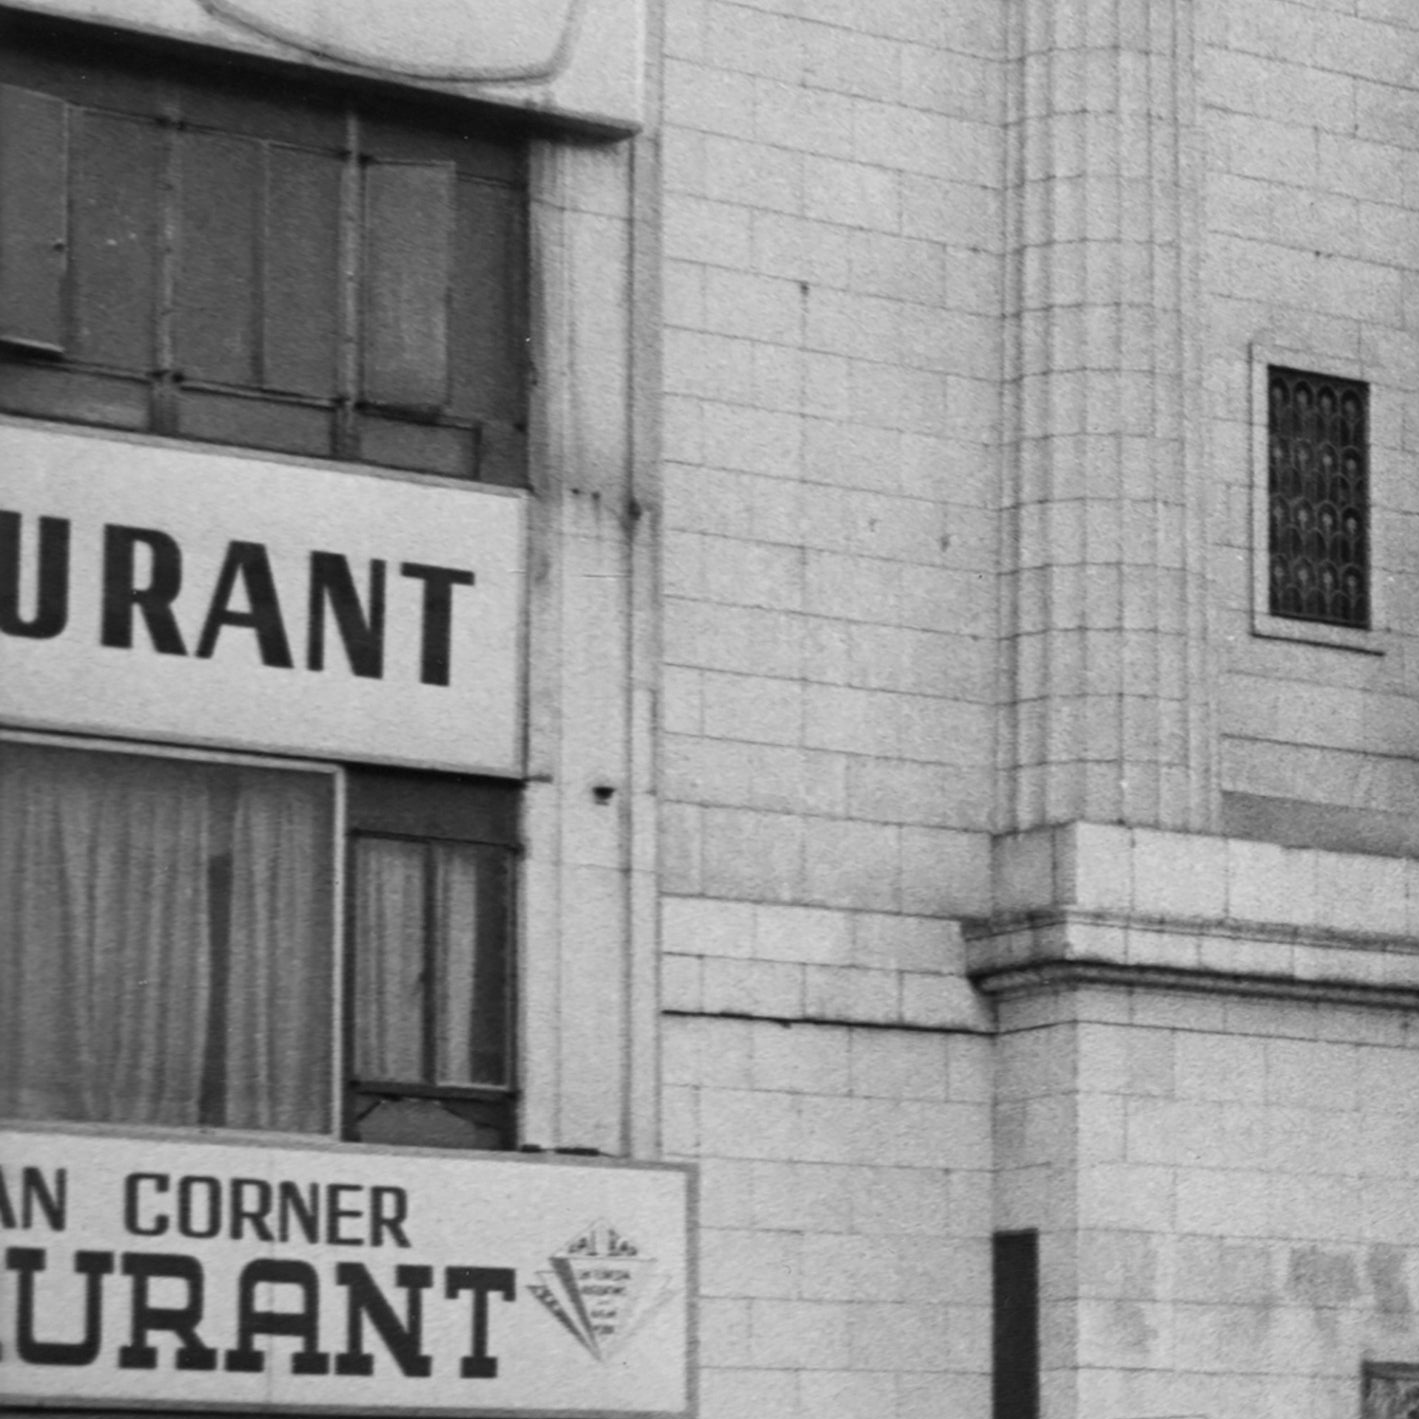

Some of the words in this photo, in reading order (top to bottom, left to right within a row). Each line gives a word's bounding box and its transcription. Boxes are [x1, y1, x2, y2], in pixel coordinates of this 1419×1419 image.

[0, 510, 475, 687] URANT
[123, 1172, 411, 1248] CORNER
[6, 1246, 517, 1379] URANT
